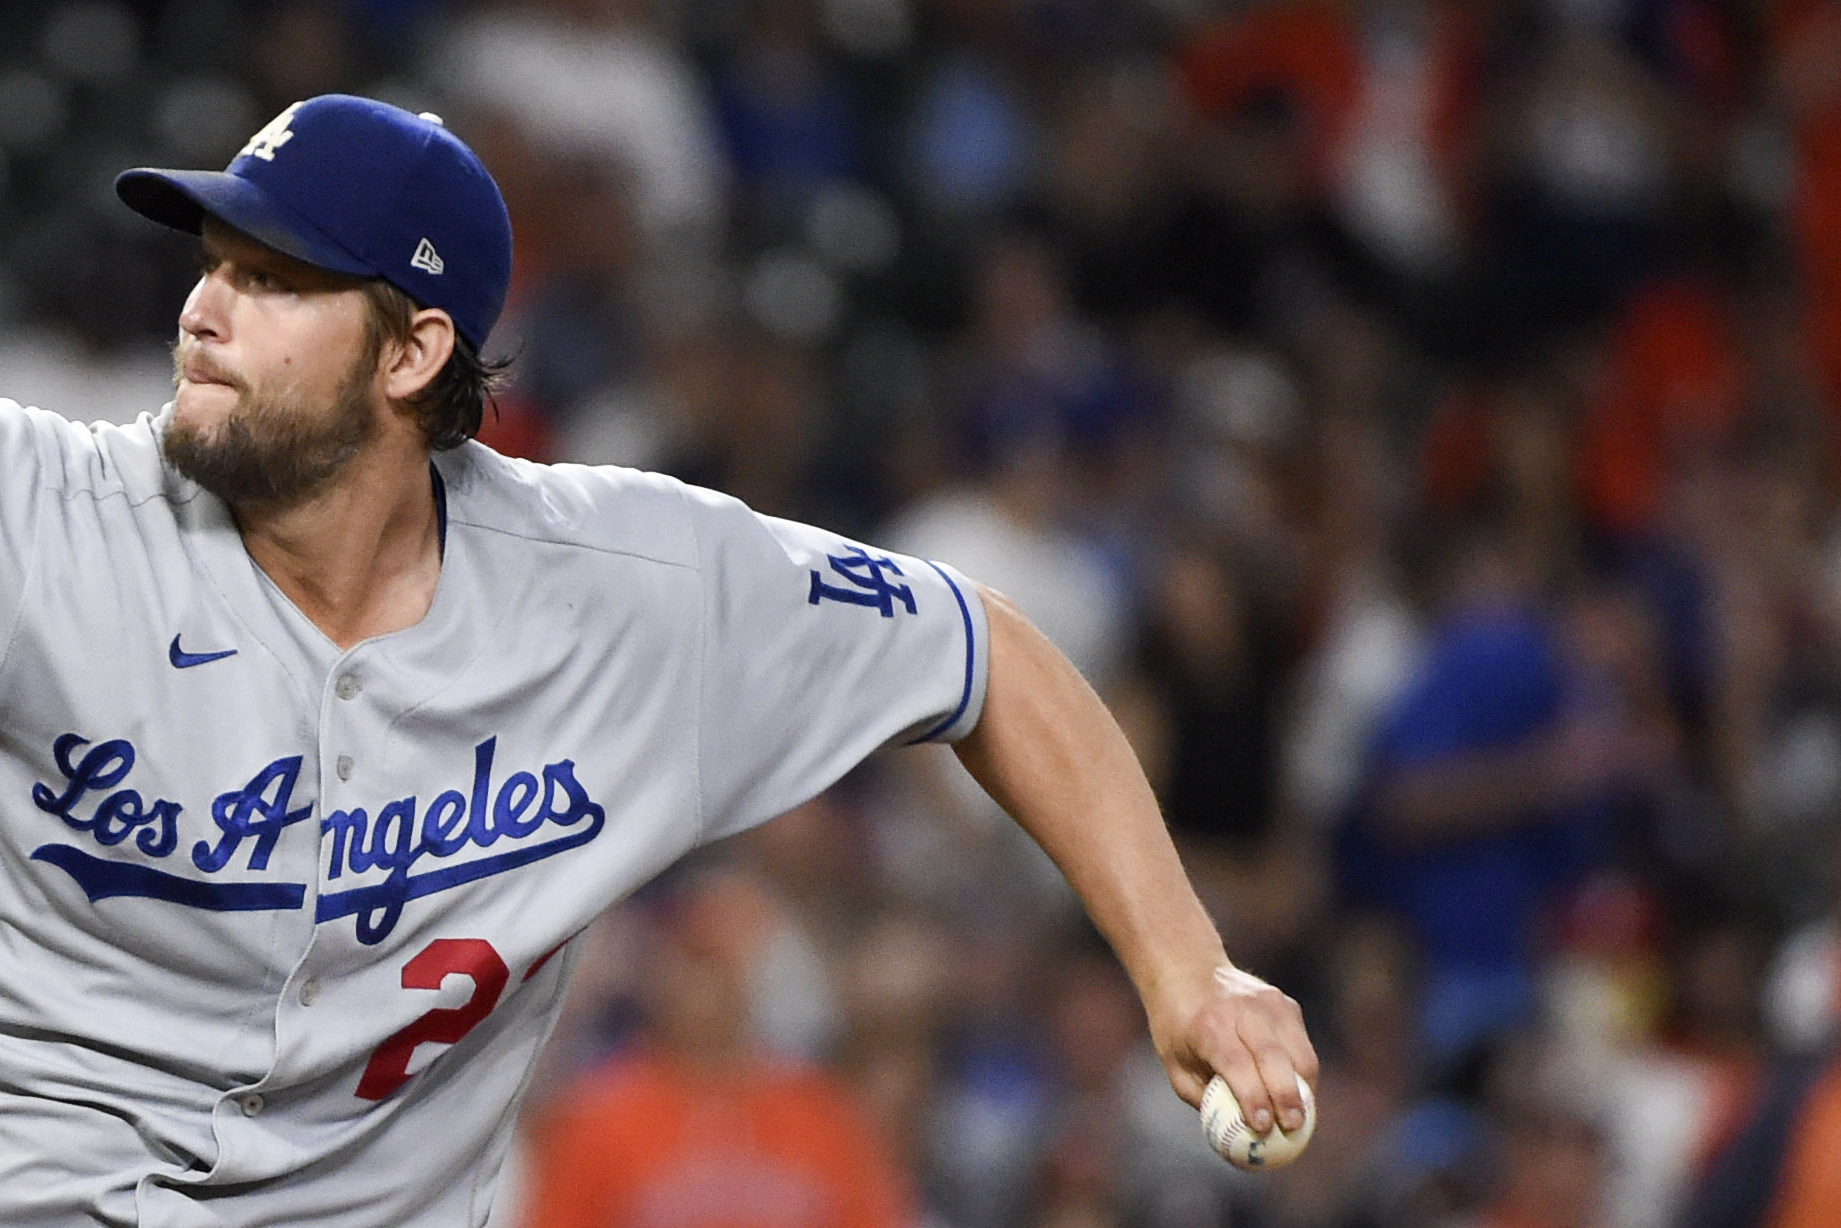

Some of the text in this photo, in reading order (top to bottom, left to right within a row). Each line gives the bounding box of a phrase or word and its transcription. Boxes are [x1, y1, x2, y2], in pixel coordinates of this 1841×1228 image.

[235, 101, 306, 161] A
[809, 544, 918, 618] LA
[32, 733, 605, 945] Los Angeles
